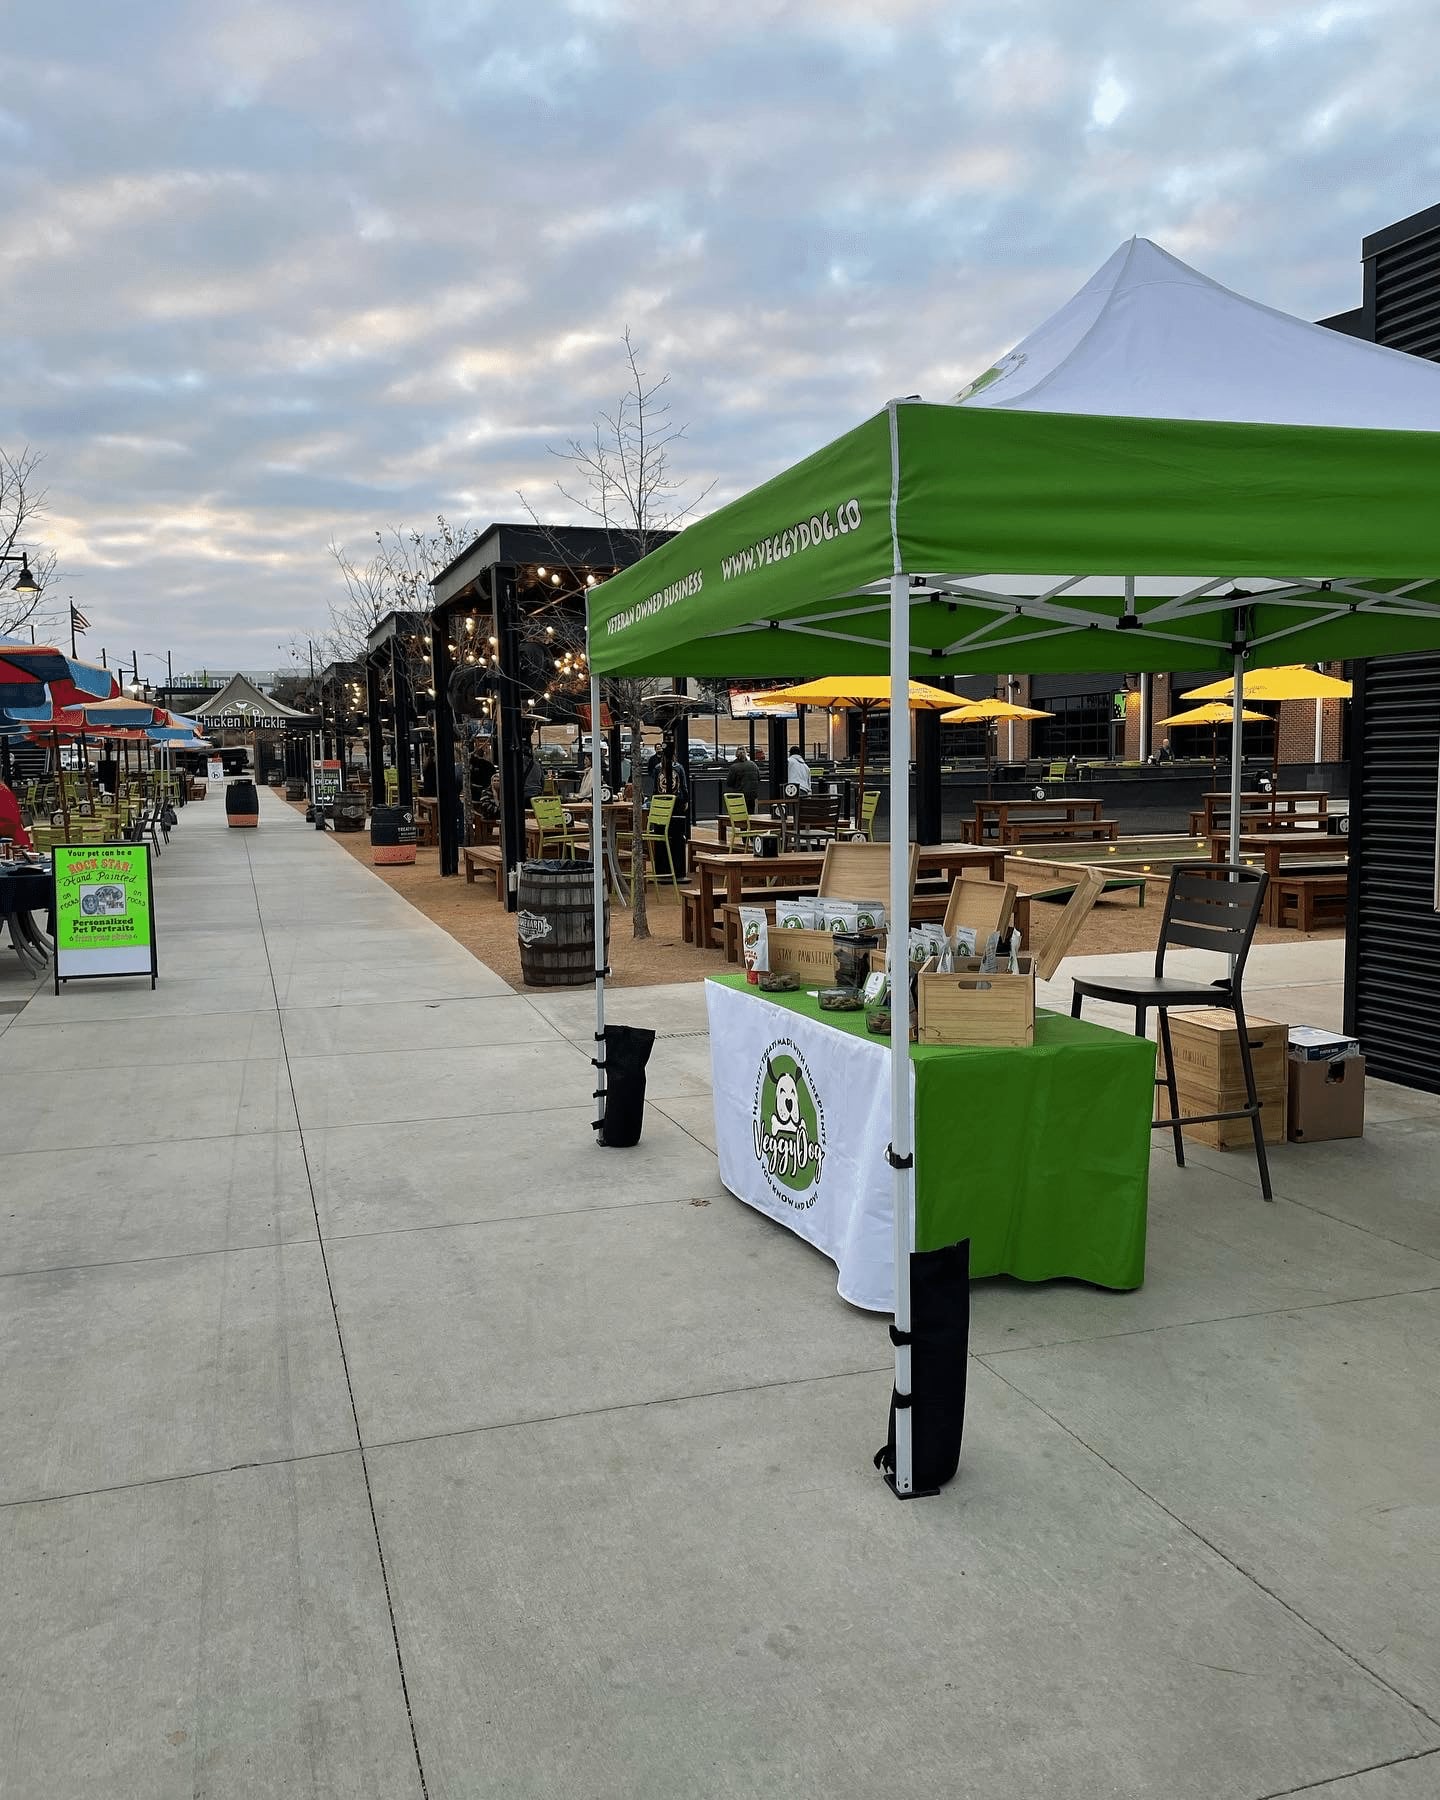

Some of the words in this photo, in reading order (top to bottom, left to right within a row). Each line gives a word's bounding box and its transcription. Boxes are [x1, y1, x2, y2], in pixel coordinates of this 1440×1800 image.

[720, 497, 862, 582] WWW.VEGGYDOG.CO
[606, 607, 634, 636] VETERAN
[636, 591, 663, 623] OWNED
[664, 568, 703, 609] BUSINESS
[243, 715, 251, 728] N
[319, 786, 336, 794] HERE
[67, 858, 98, 874] ROCK
[64, 874, 92, 886] Hand
[96, 871, 137, 884] Painted
[60, 898, 79, 910] rocks
[127, 896, 145, 907] rocks
[73, 918, 133, 926] Personalized
[91, 925, 134, 933] Portraits
[777, 949, 792, 961] STAY
[793, 1042, 805, 1066] WITH
[805, 1065, 826, 1145] INGREDIENTS
[753, 1120, 825, 1184] VeggyDog
[762, 1161, 772, 1184] YOU
[772, 1185, 793, 1207] KNOW
